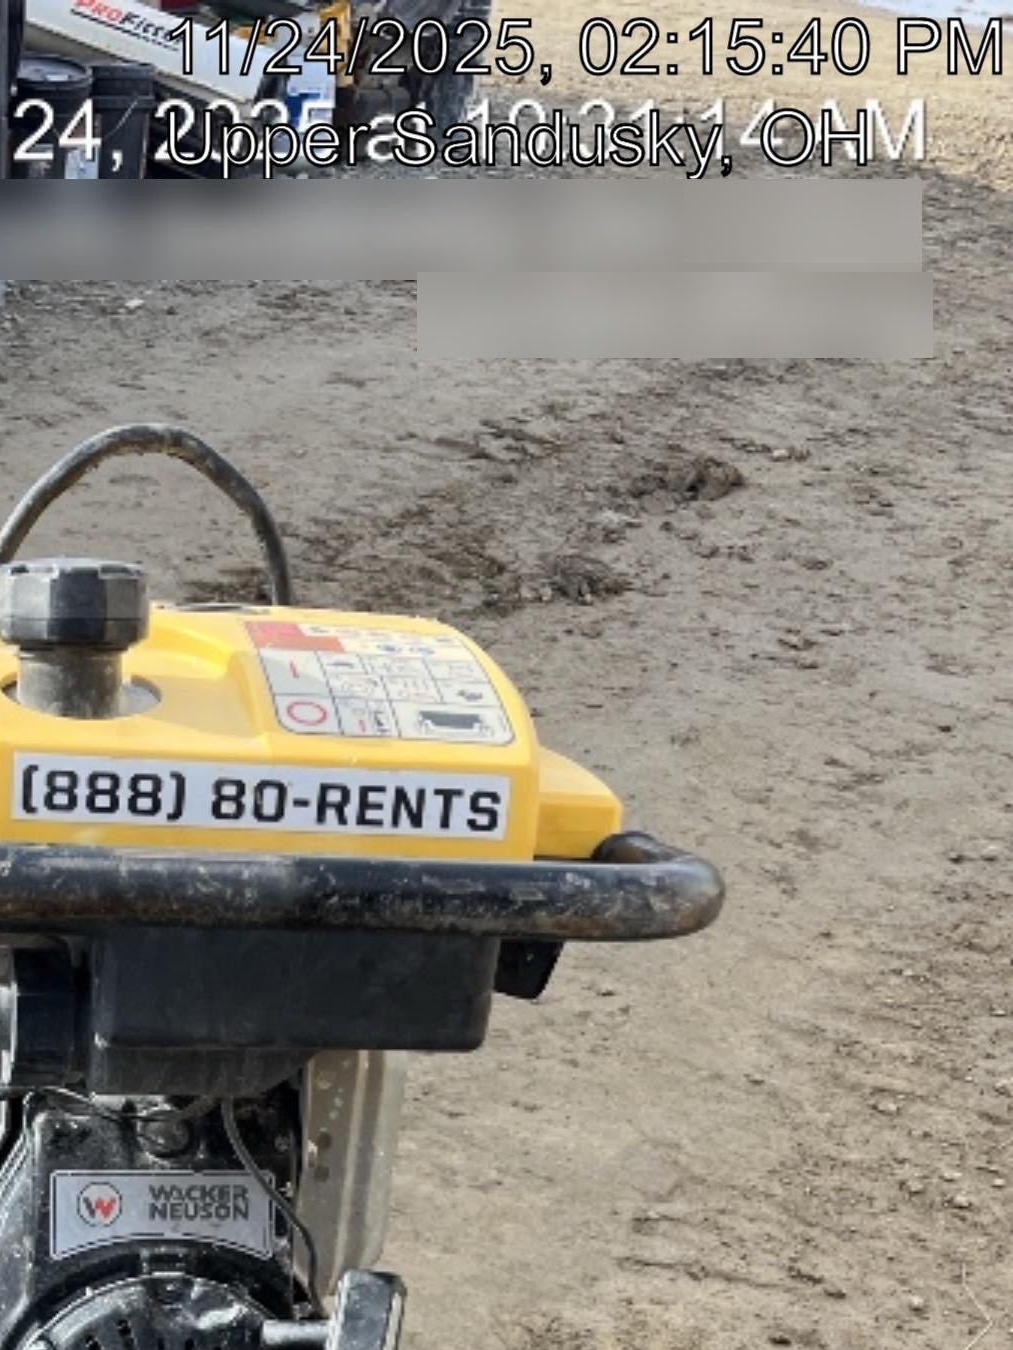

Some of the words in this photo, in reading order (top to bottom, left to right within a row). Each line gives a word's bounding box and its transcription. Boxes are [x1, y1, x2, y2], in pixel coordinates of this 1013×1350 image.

[22, 765, 186, 822] (888)
[212, 778, 501, 832] 80-RENTS
[148, 1184, 249, 1201] WACKER
[148, 1202, 249, 1221] NEUSON
